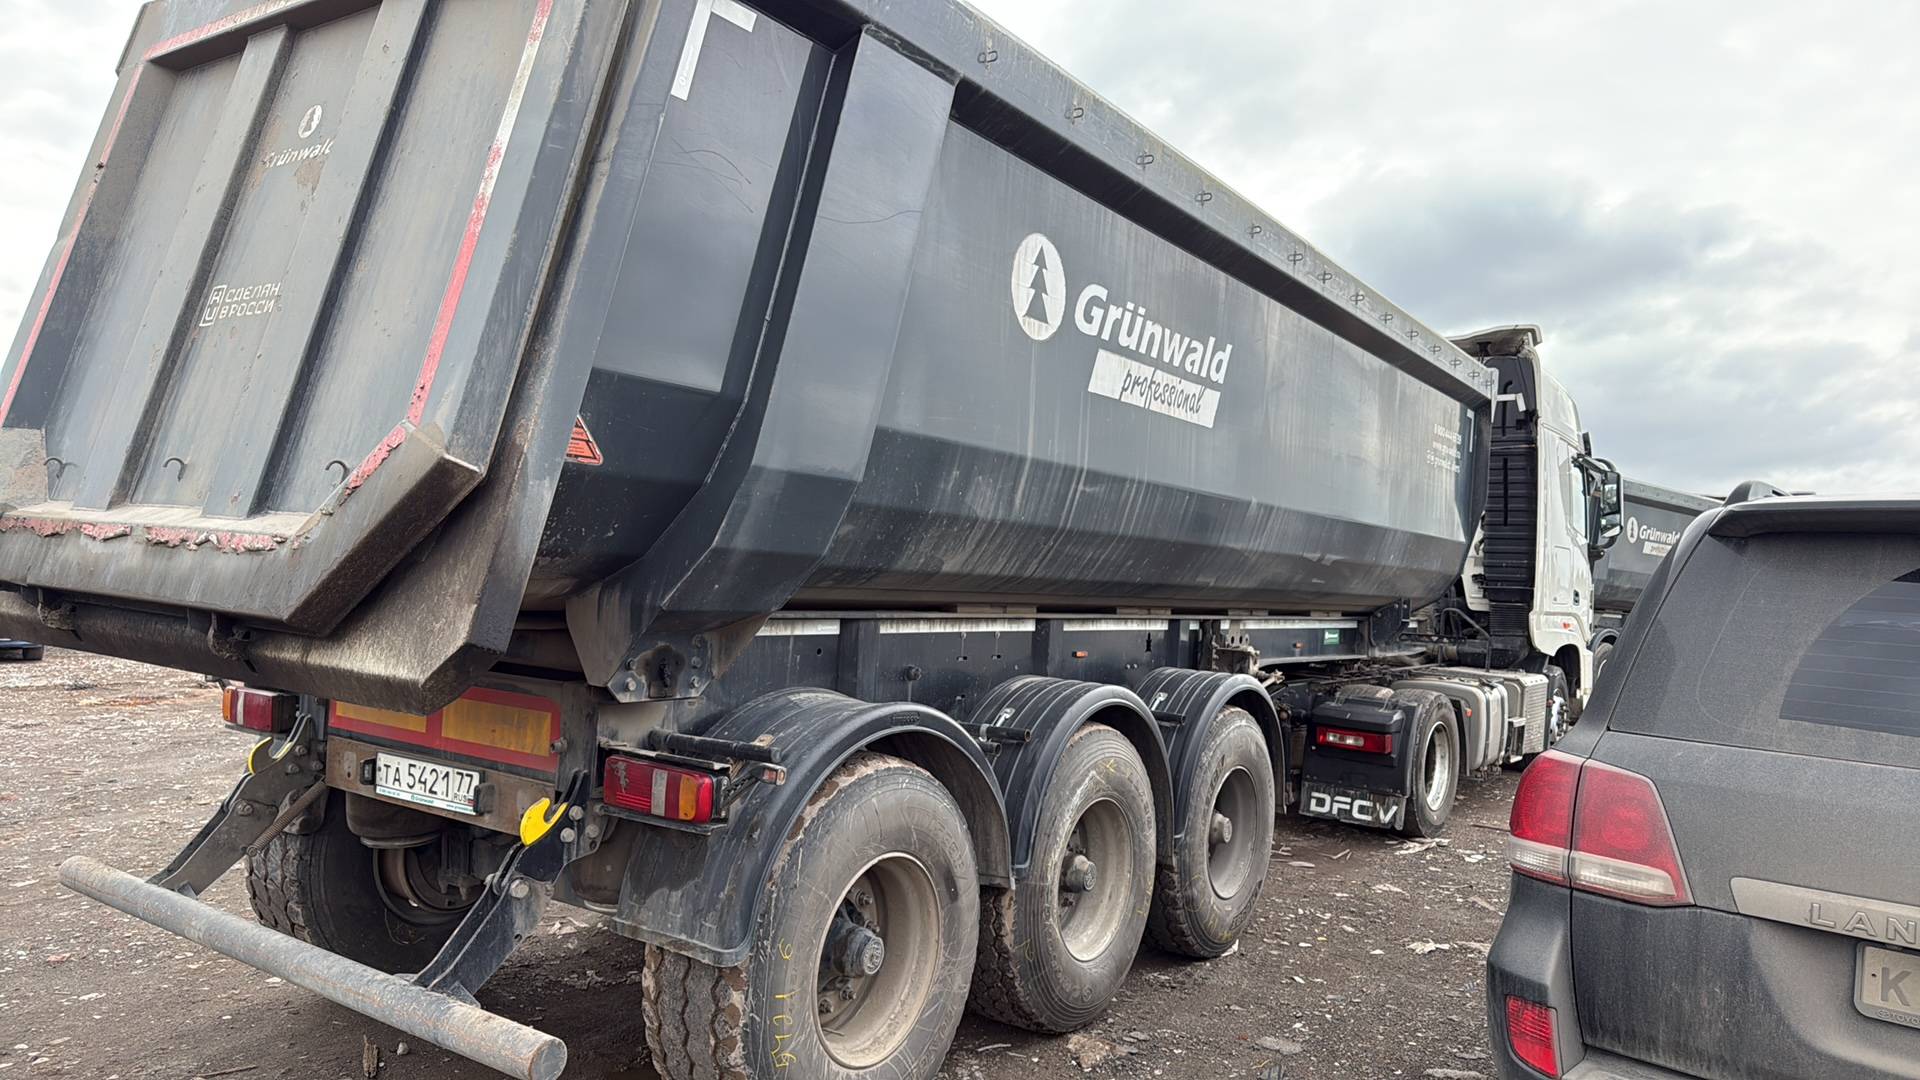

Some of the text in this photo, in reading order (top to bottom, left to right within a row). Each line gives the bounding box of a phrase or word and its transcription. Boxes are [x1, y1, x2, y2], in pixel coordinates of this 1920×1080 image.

[1074, 284, 1232, 384] Grünwald
[1119, 367, 1206, 414] professional
[406, 763, 450, 798] 5421
[456, 771, 474, 794] 77
[1309, 791, 1398, 823] DFCV
